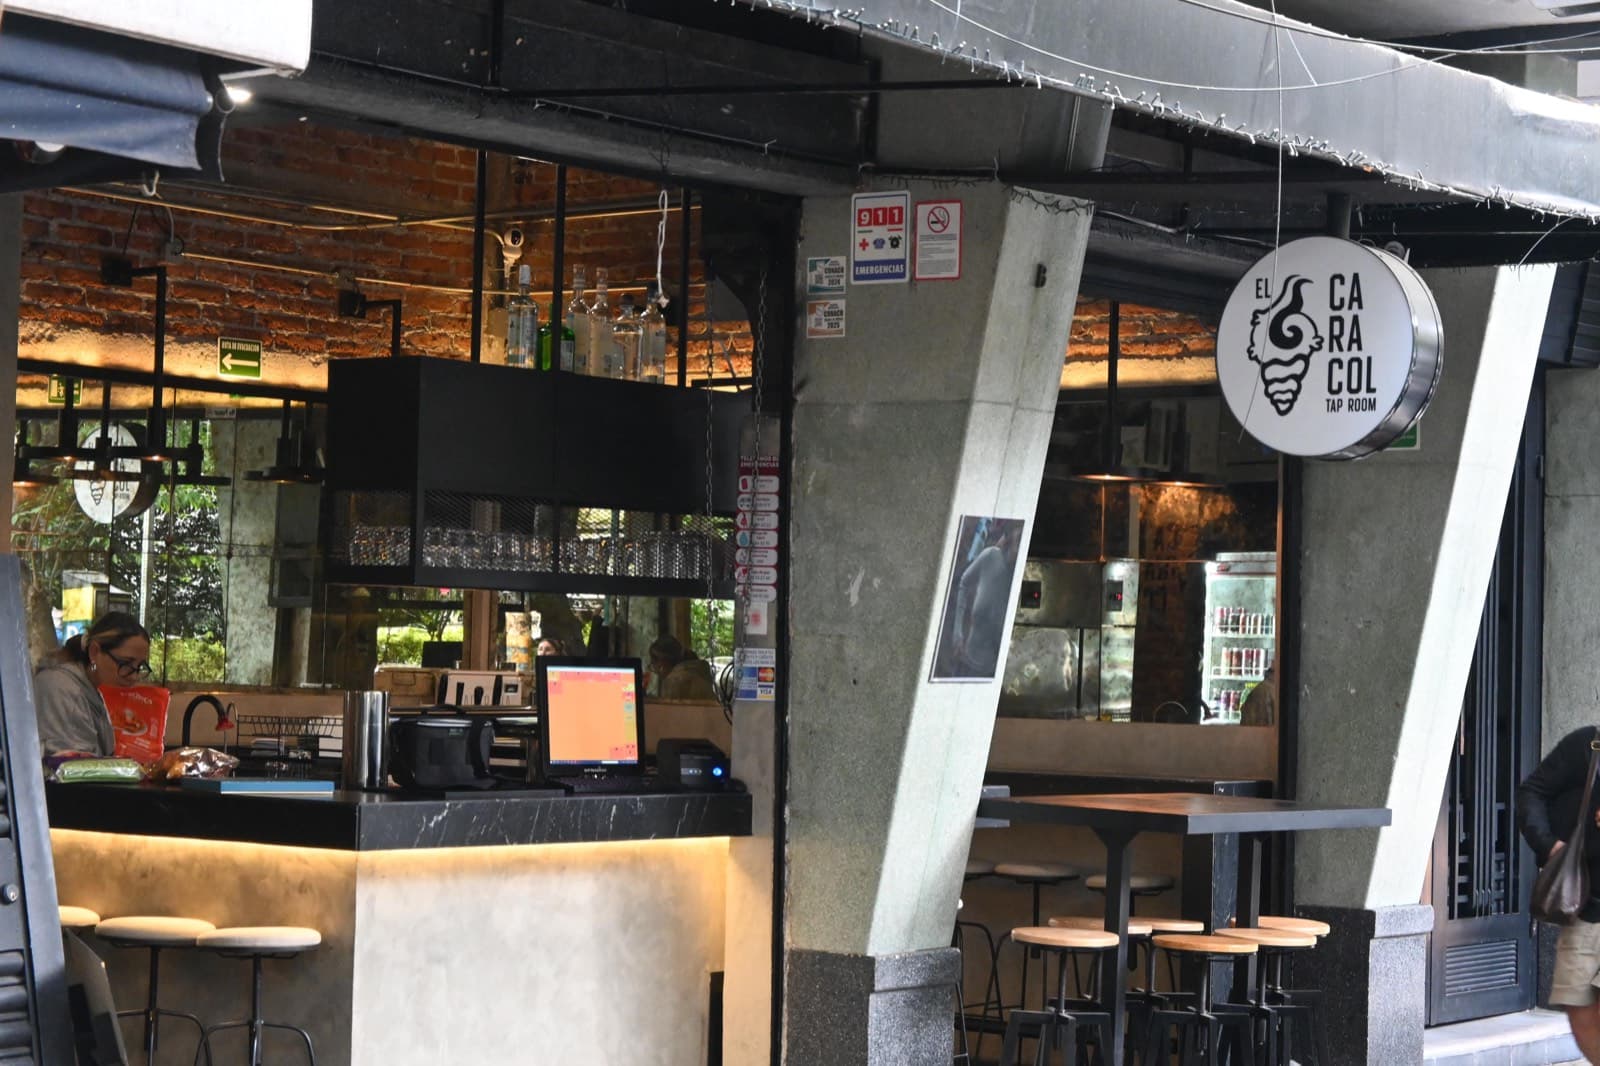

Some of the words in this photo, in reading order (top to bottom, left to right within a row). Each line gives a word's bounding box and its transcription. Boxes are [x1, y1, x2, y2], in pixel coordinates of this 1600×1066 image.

[861, 208, 899, 225] 911
[855, 264, 905, 275] EMERGENCIAS
[1255, 278, 1271, 299] EL
[1329, 272, 1364, 311] CA
[1328, 314, 1364, 352] RA
[1327, 356, 1377, 395] COL
[1326, 398, 1343, 413] TAP
[1347, 398, 1377, 412] ROOM
